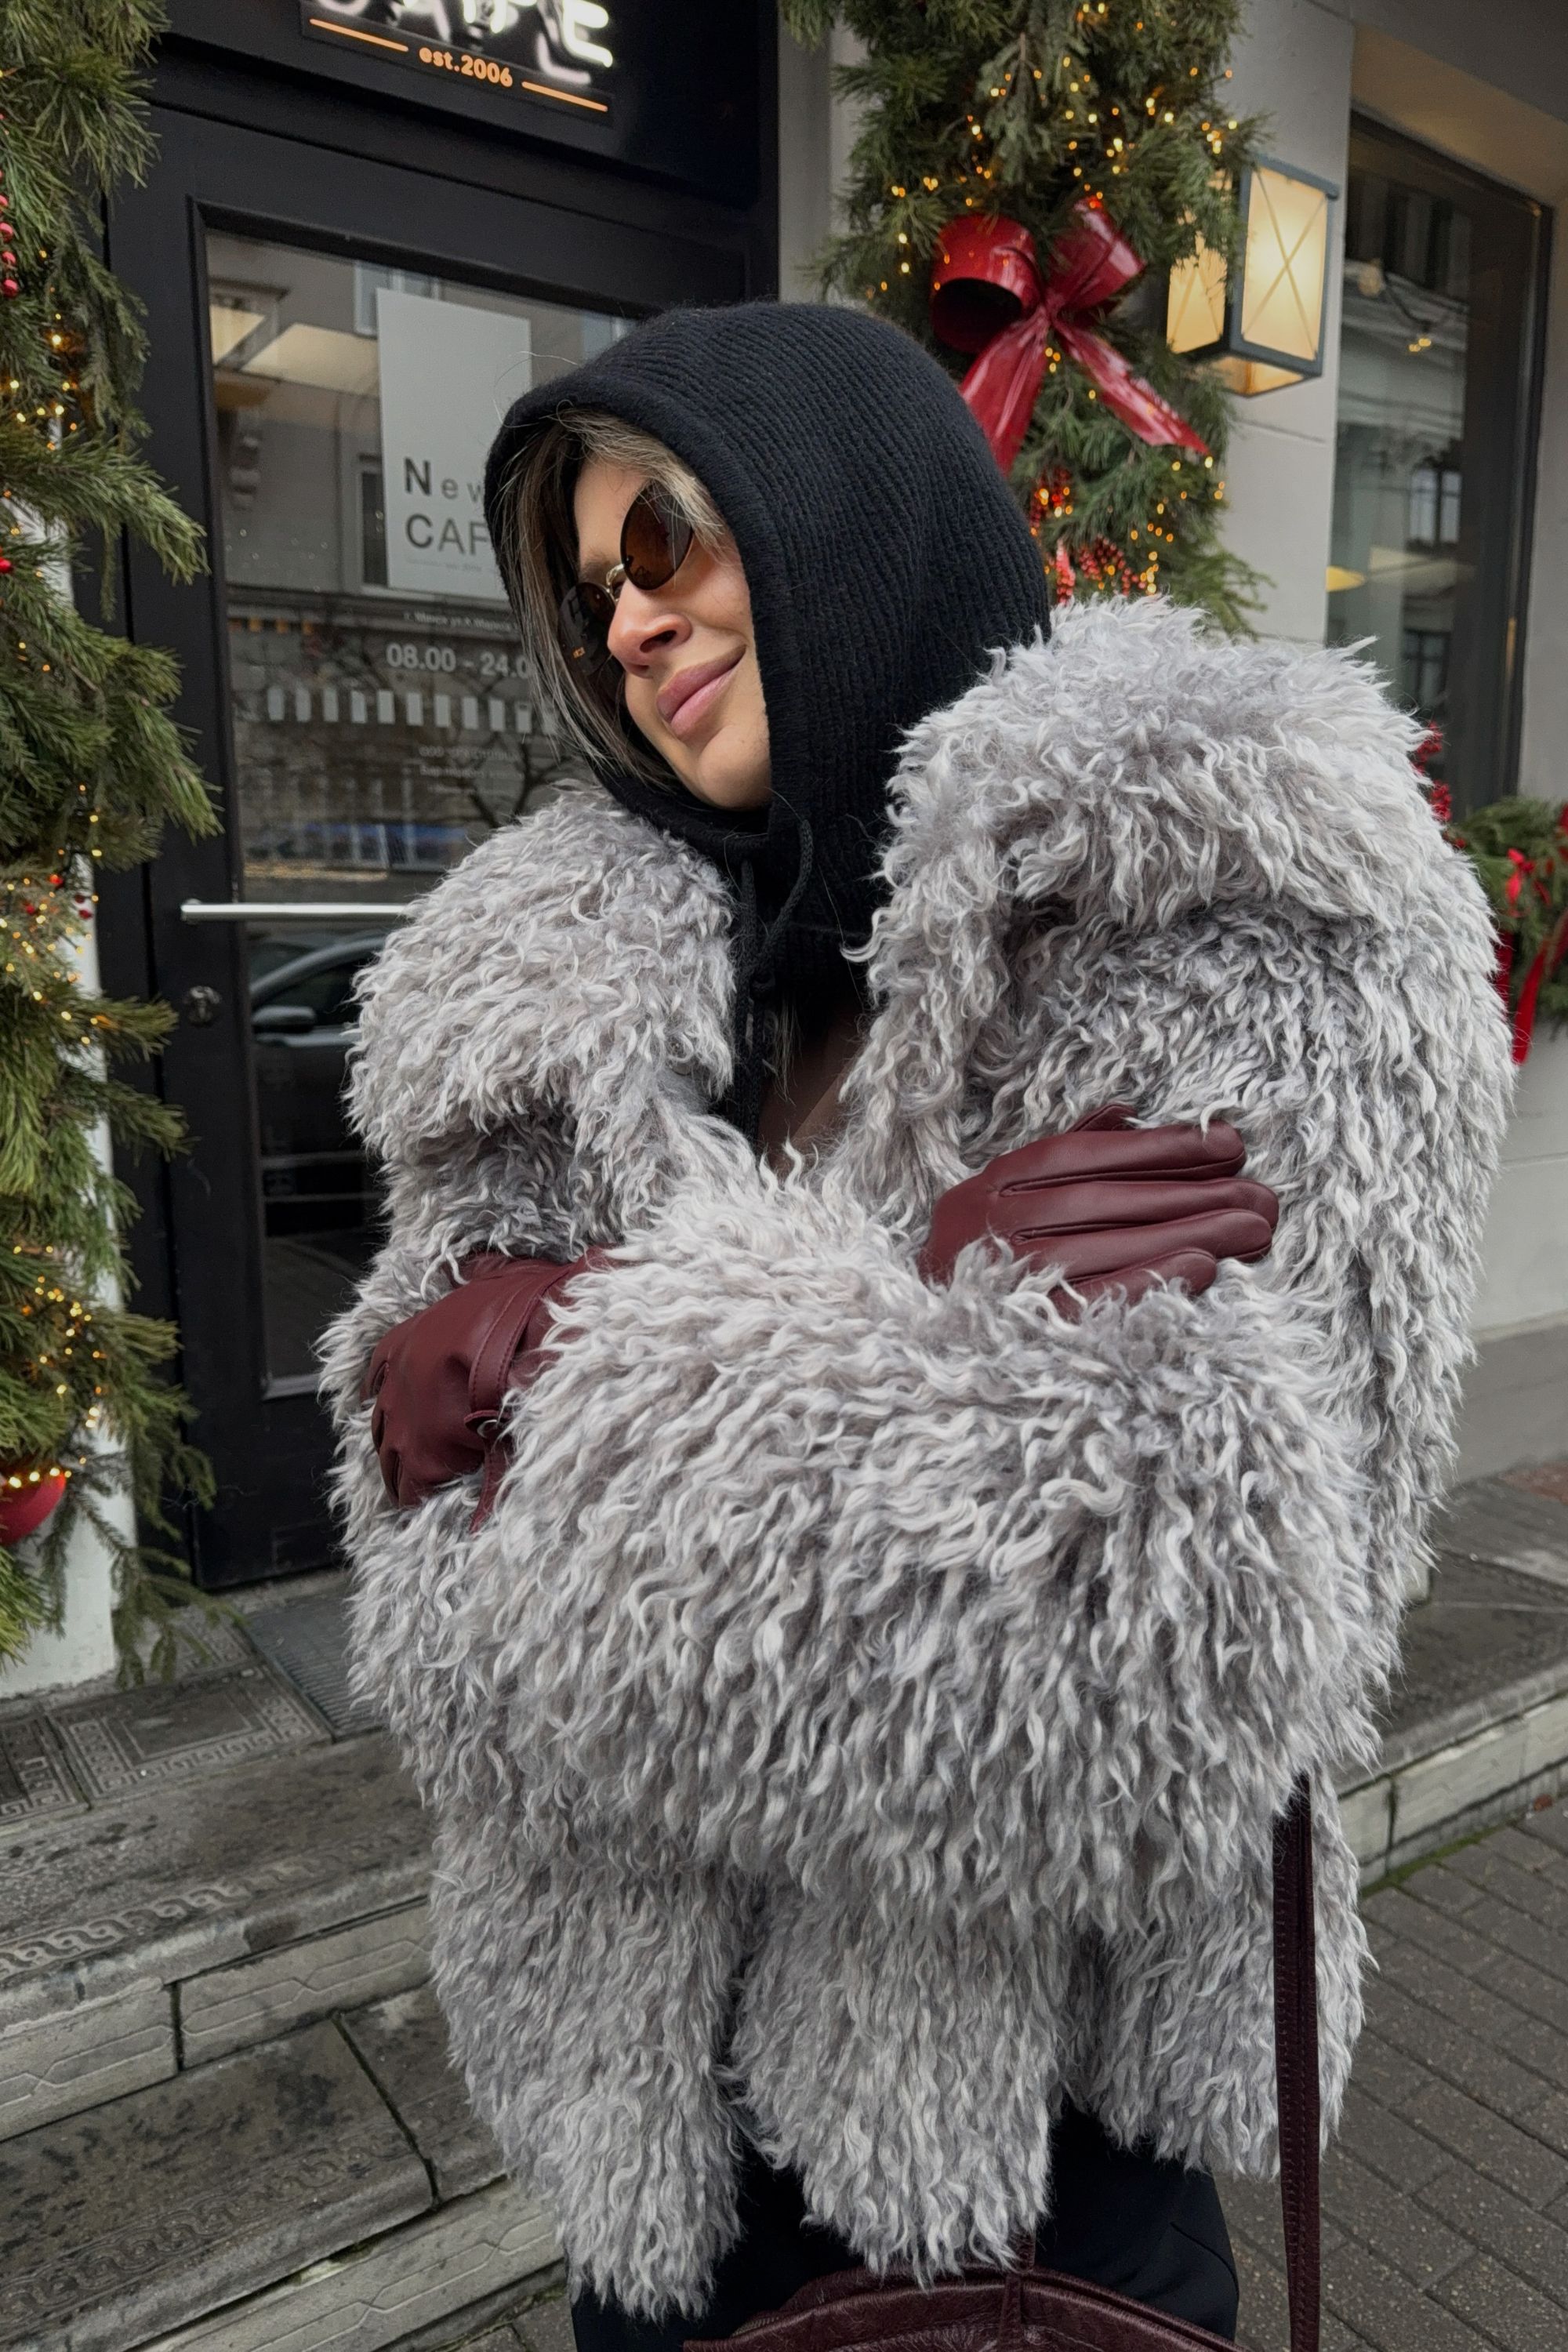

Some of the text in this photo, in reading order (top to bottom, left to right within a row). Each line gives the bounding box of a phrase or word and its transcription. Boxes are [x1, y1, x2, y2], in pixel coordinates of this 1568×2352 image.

[419, 47, 514, 88] est.2006
[405, 514, 492, 555] CAF
[386, 643, 456, 672] 08.00
[480, 651, 529, 679] 24.0
